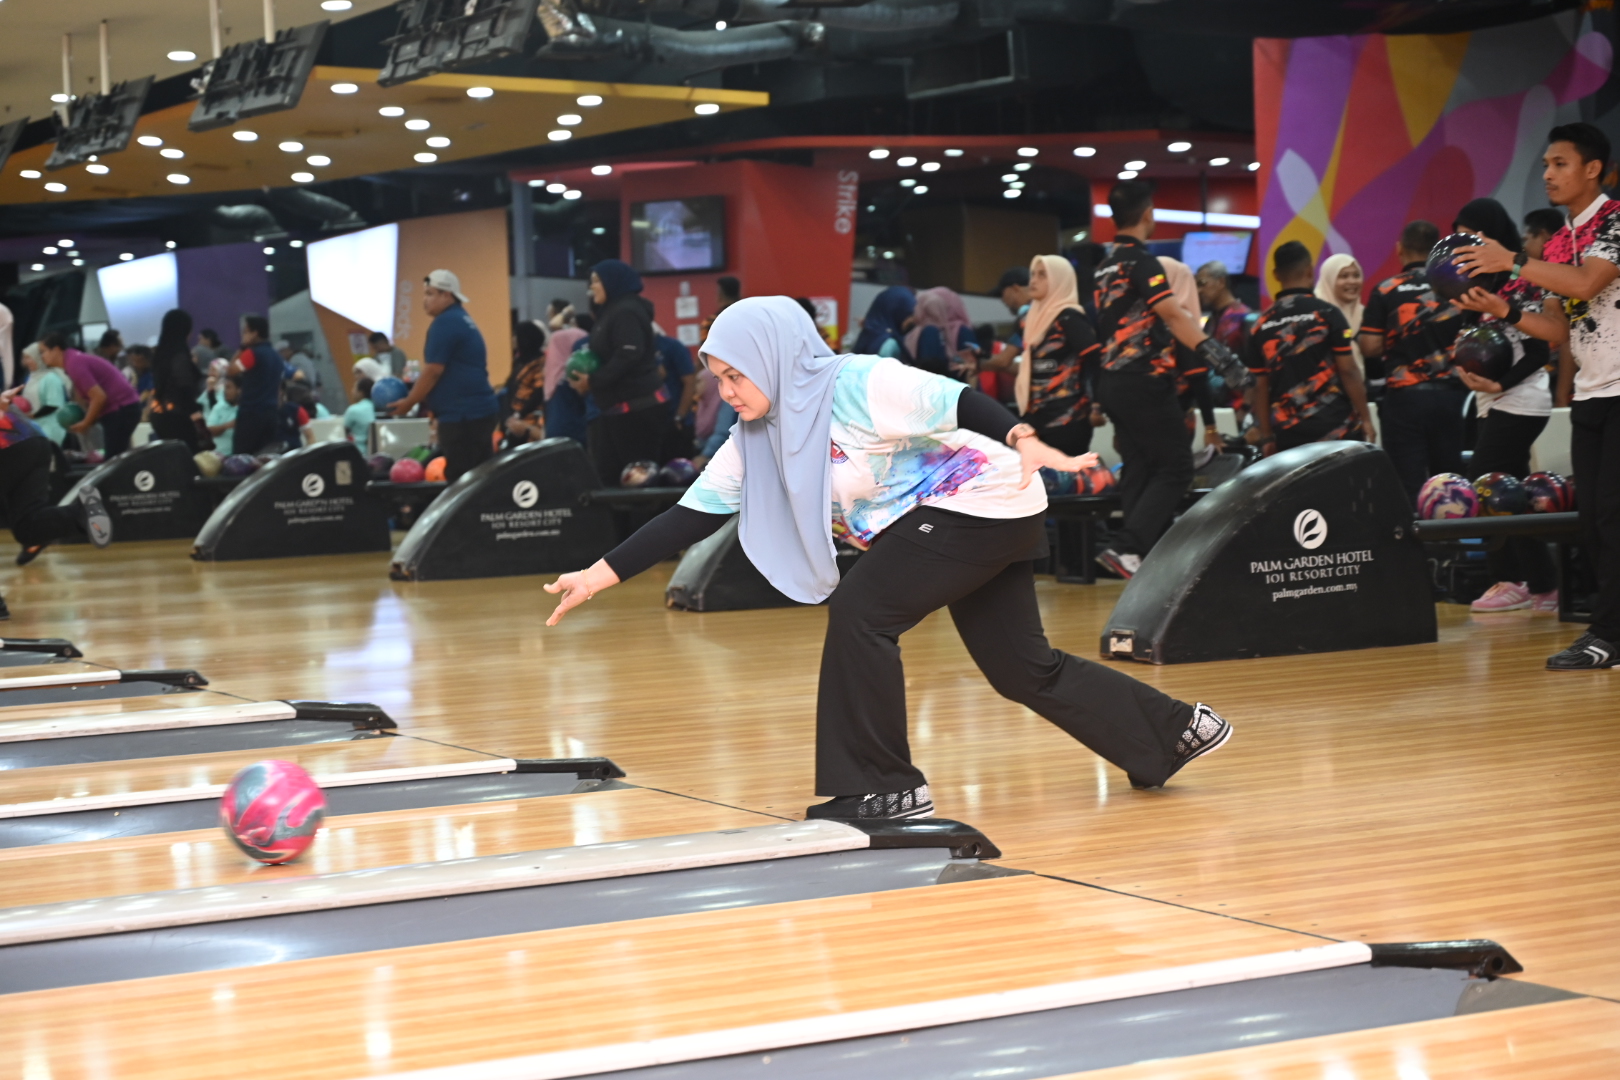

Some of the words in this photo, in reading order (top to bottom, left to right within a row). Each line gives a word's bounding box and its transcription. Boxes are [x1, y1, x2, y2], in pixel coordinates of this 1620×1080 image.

[480, 512, 504, 522] PALM
[505, 510, 542, 521] GARDEN
[543, 508, 573, 518] HOTEL
[1250, 560, 1282, 573] PALM
[1284, 554, 1334, 570] GARDEN
[1336, 550, 1374, 565] HOTEL
[1289, 567, 1333, 582] RESORT
[1335, 564, 1361, 578] CITY
[1272, 583, 1358, 602] palmgarden.com.my
